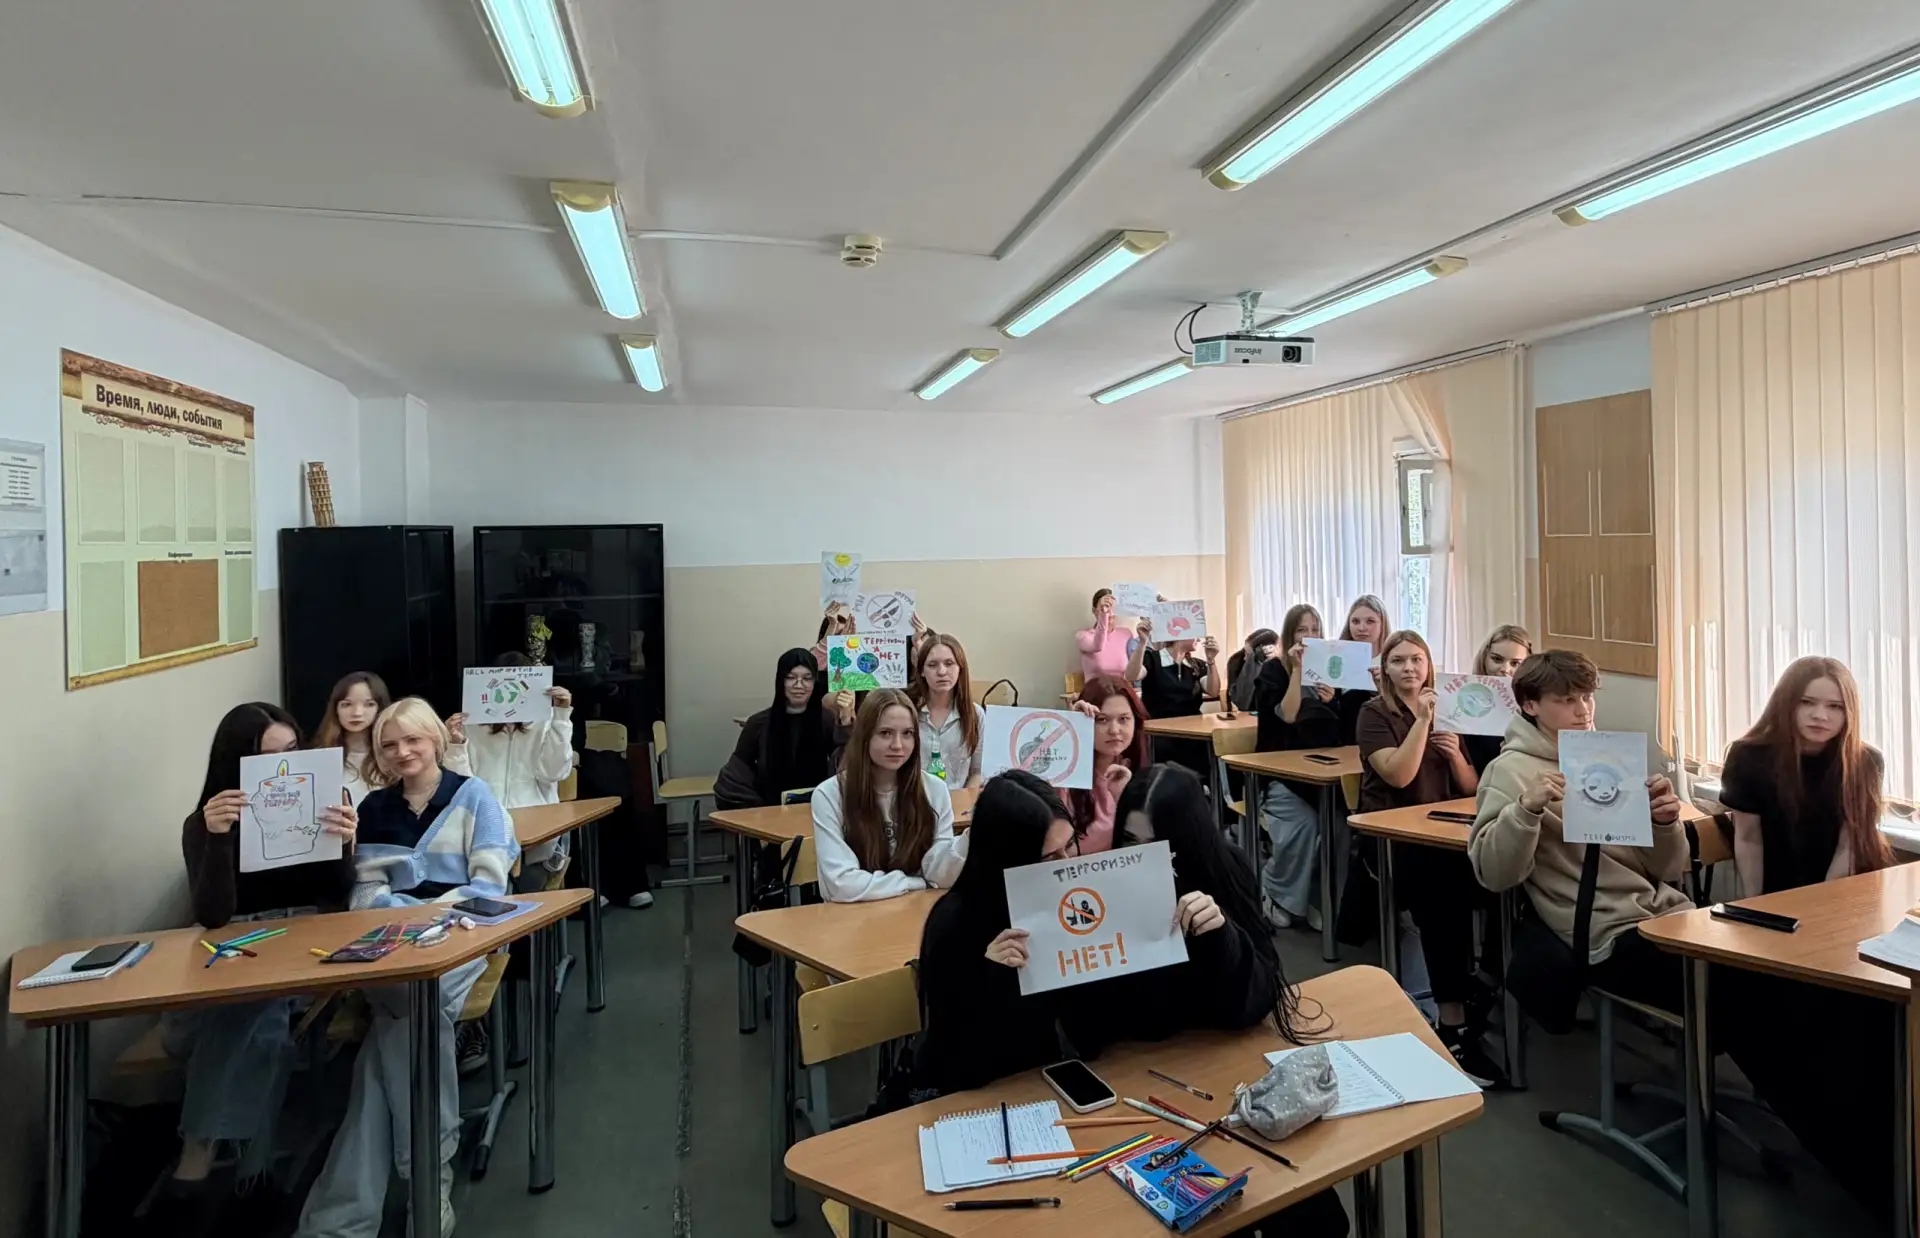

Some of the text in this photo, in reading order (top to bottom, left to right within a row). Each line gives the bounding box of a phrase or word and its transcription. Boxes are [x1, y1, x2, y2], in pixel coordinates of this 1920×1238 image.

[96, 384, 222, 430] Время, люди, события
[879, 652, 900, 660] НЕТ
[1305, 668, 1322, 681] НЕТ
[1444, 674, 1469, 694] НЕТ
[1053, 852, 1143, 882] ТЕРРОРИЗМУ
[1058, 932, 1127, 977] НЕТ!
